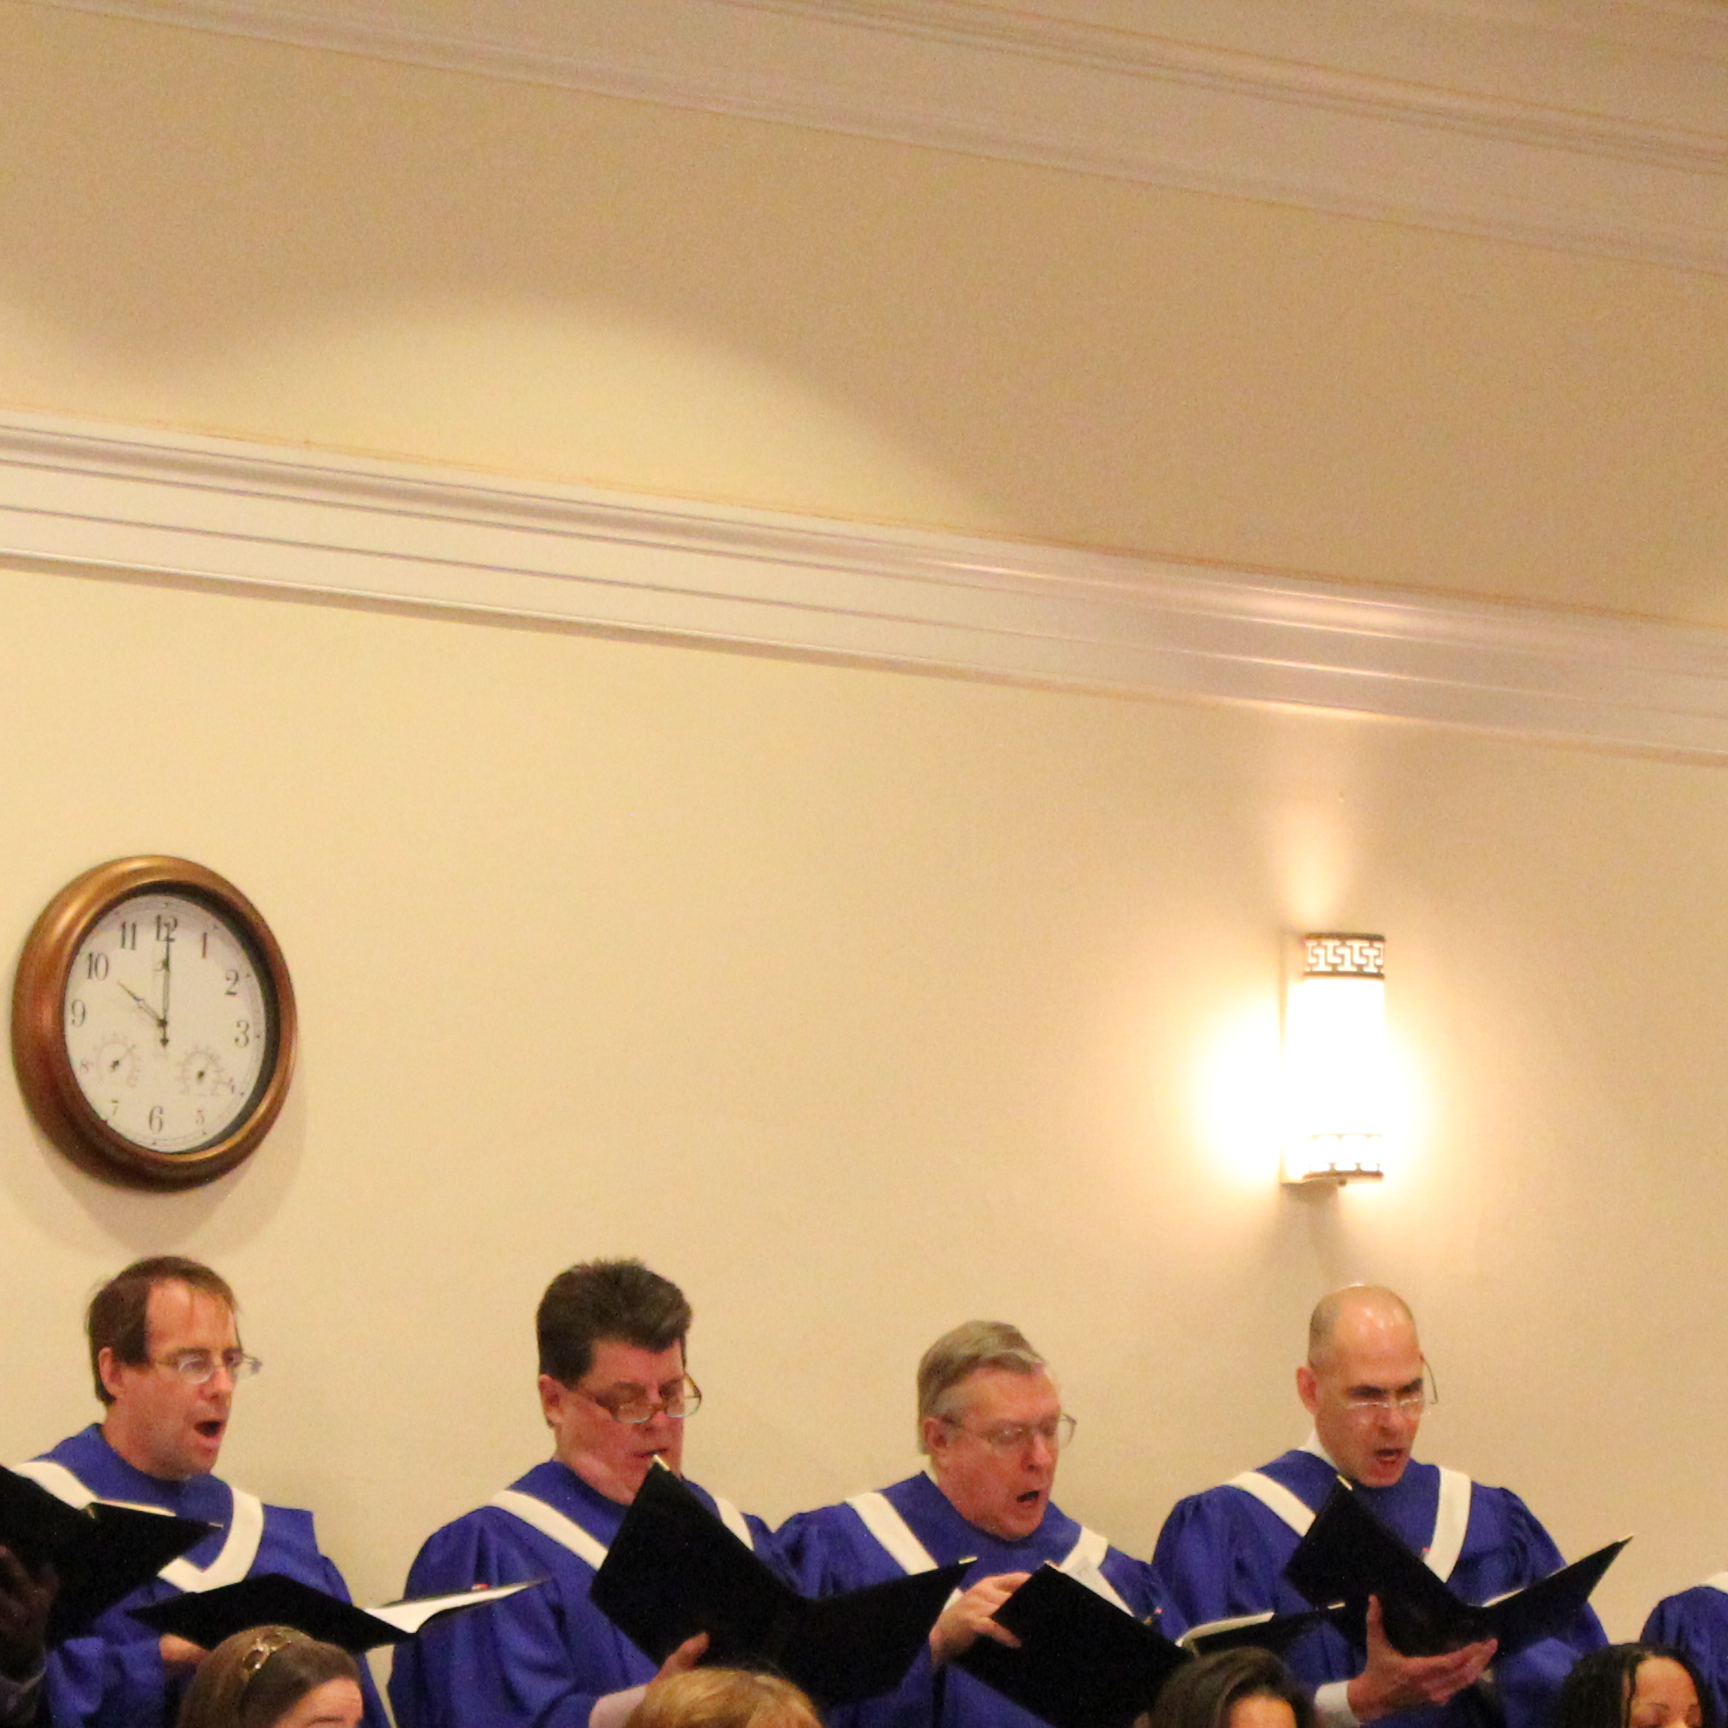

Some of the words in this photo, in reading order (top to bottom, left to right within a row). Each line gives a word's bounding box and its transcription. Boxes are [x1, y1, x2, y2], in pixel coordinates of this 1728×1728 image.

[120, 920, 137, 950] 11
[154, 913, 178, 942] 12
[201, 931, 208, 959] 1
[88, 953, 109, 981] 10
[225, 970, 239, 996] 2
[70, 999, 86, 1028] 9
[234, 1019, 250, 1048] 3
[148, 1105, 164, 1135] 6
